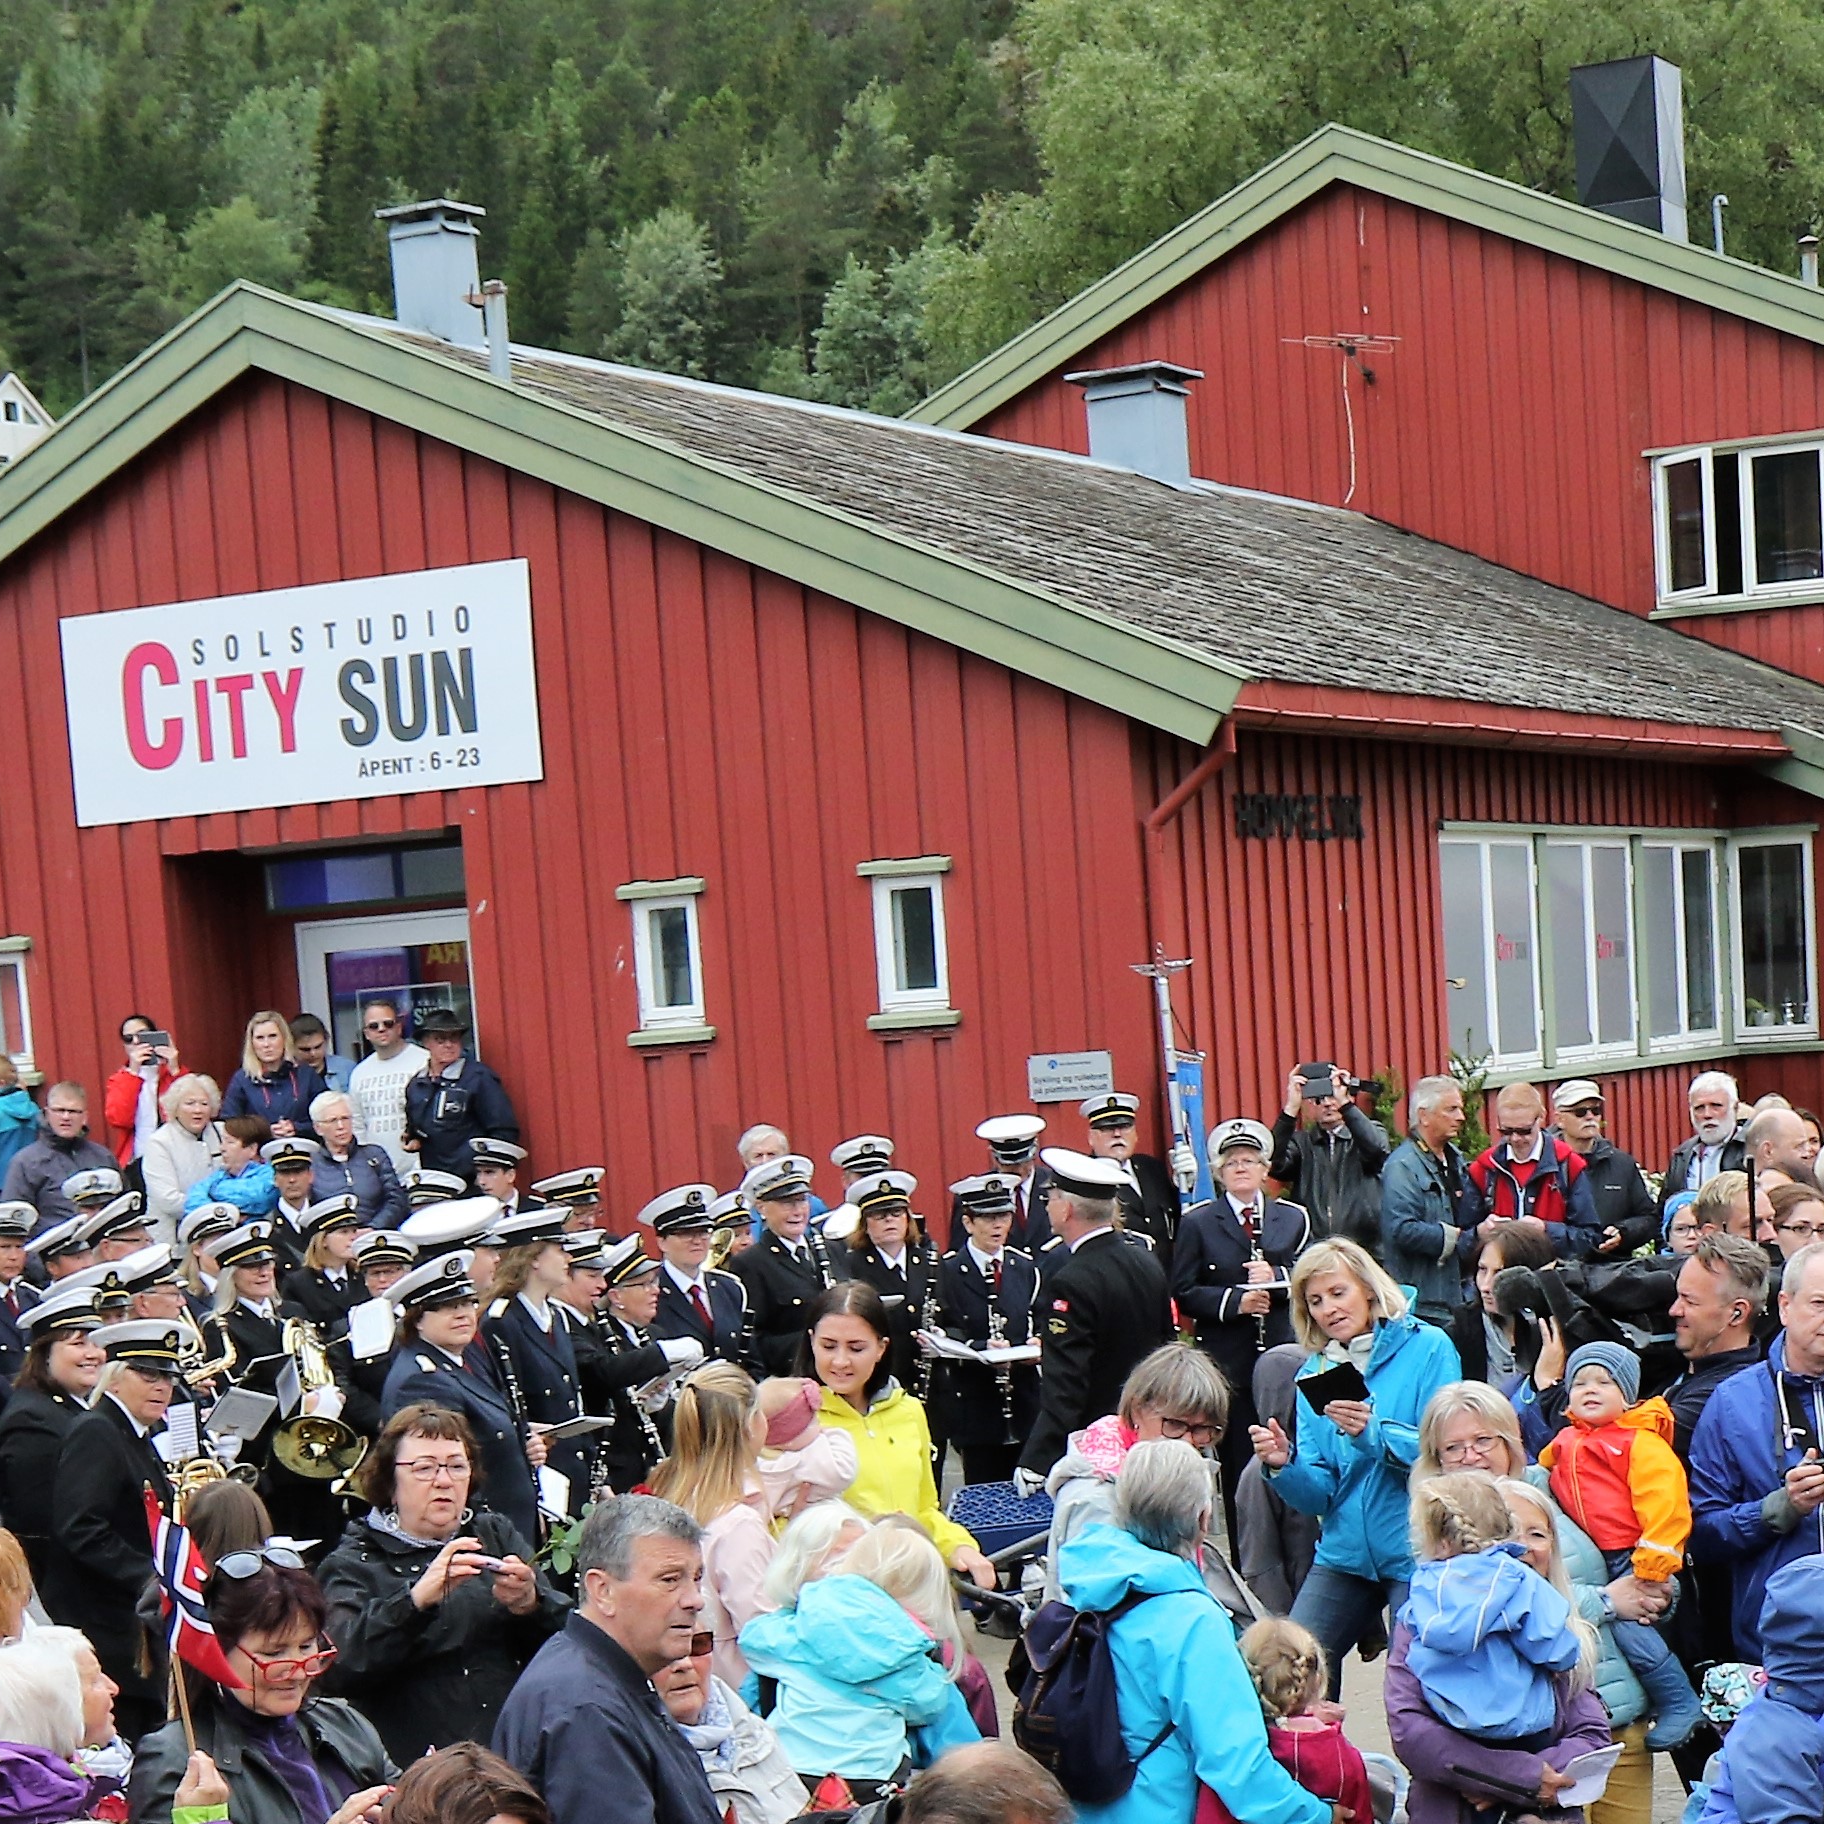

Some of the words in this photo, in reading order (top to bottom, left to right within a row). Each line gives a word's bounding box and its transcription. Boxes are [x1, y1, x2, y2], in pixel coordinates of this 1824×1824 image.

[192, 606, 471, 666] SOLSTUDIO
[337, 646, 479, 748] SUN
[358, 756, 415, 779] ÅPENT
